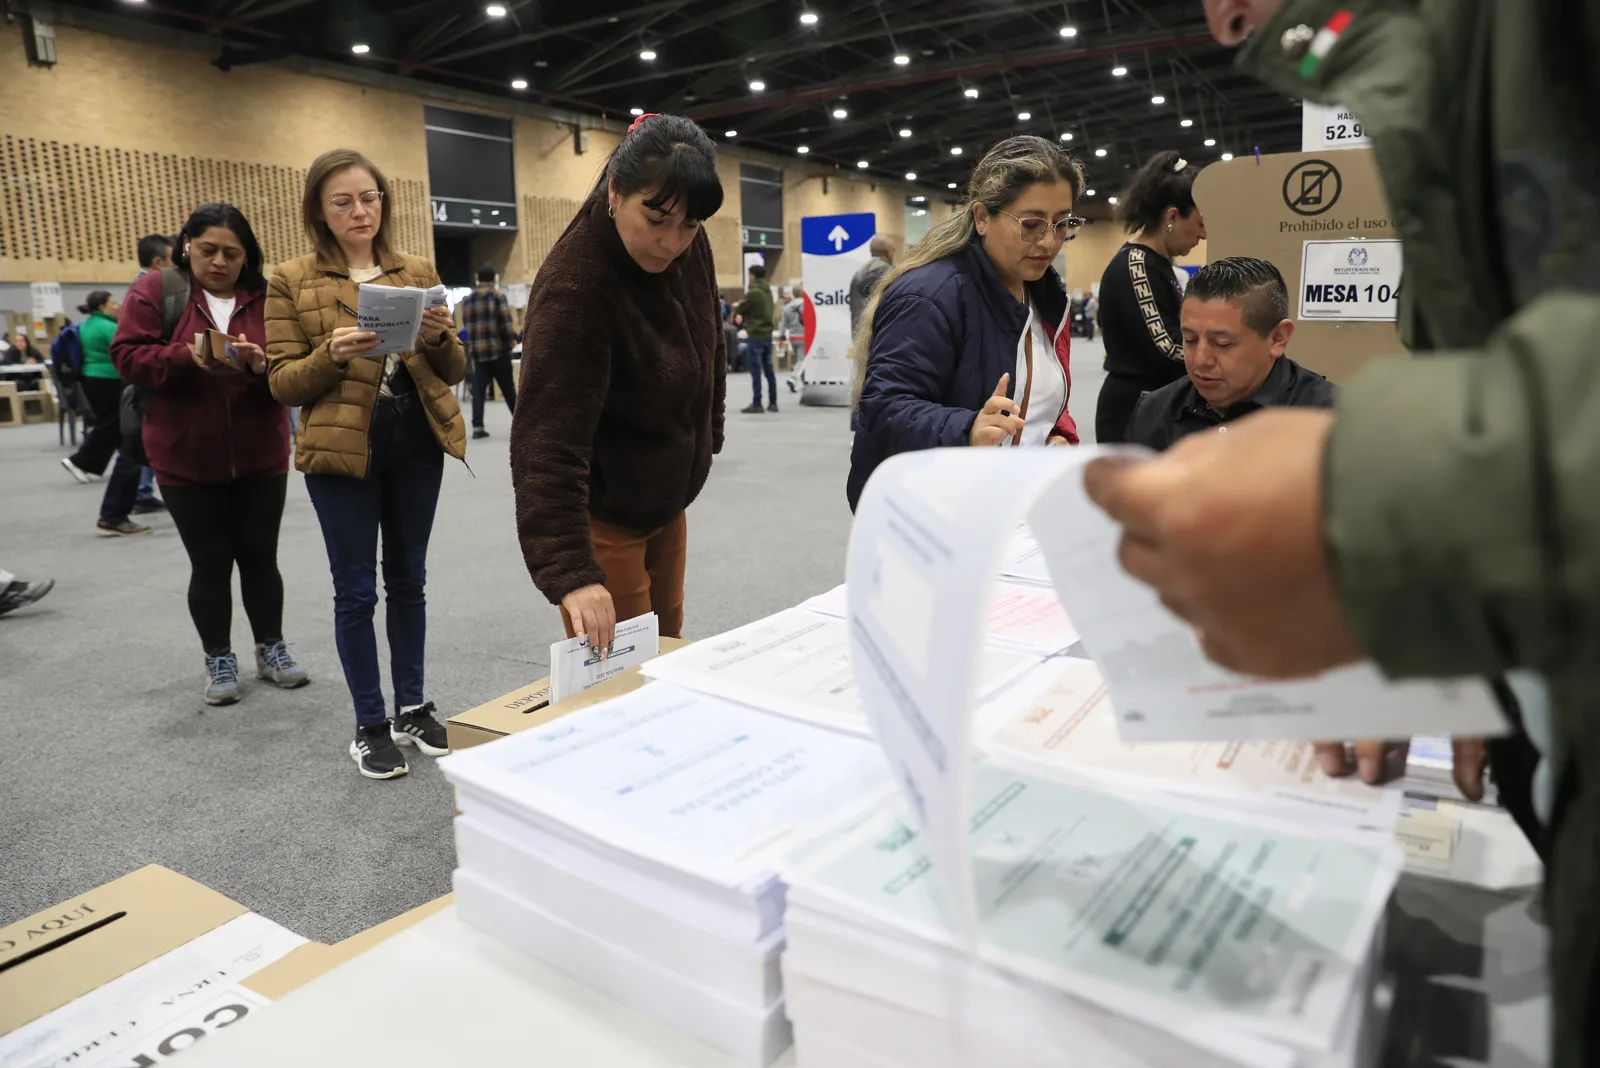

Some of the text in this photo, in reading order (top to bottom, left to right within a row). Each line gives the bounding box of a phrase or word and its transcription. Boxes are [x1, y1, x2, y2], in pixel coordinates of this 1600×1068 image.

[1279, 218, 1344, 233] Prohibido
[1347, 217, 1359, 230] el
[1364, 219, 1387, 229] uso
[1305, 284, 1359, 303] MESA
[364, 319, 410, 328] REPÚBLICA
